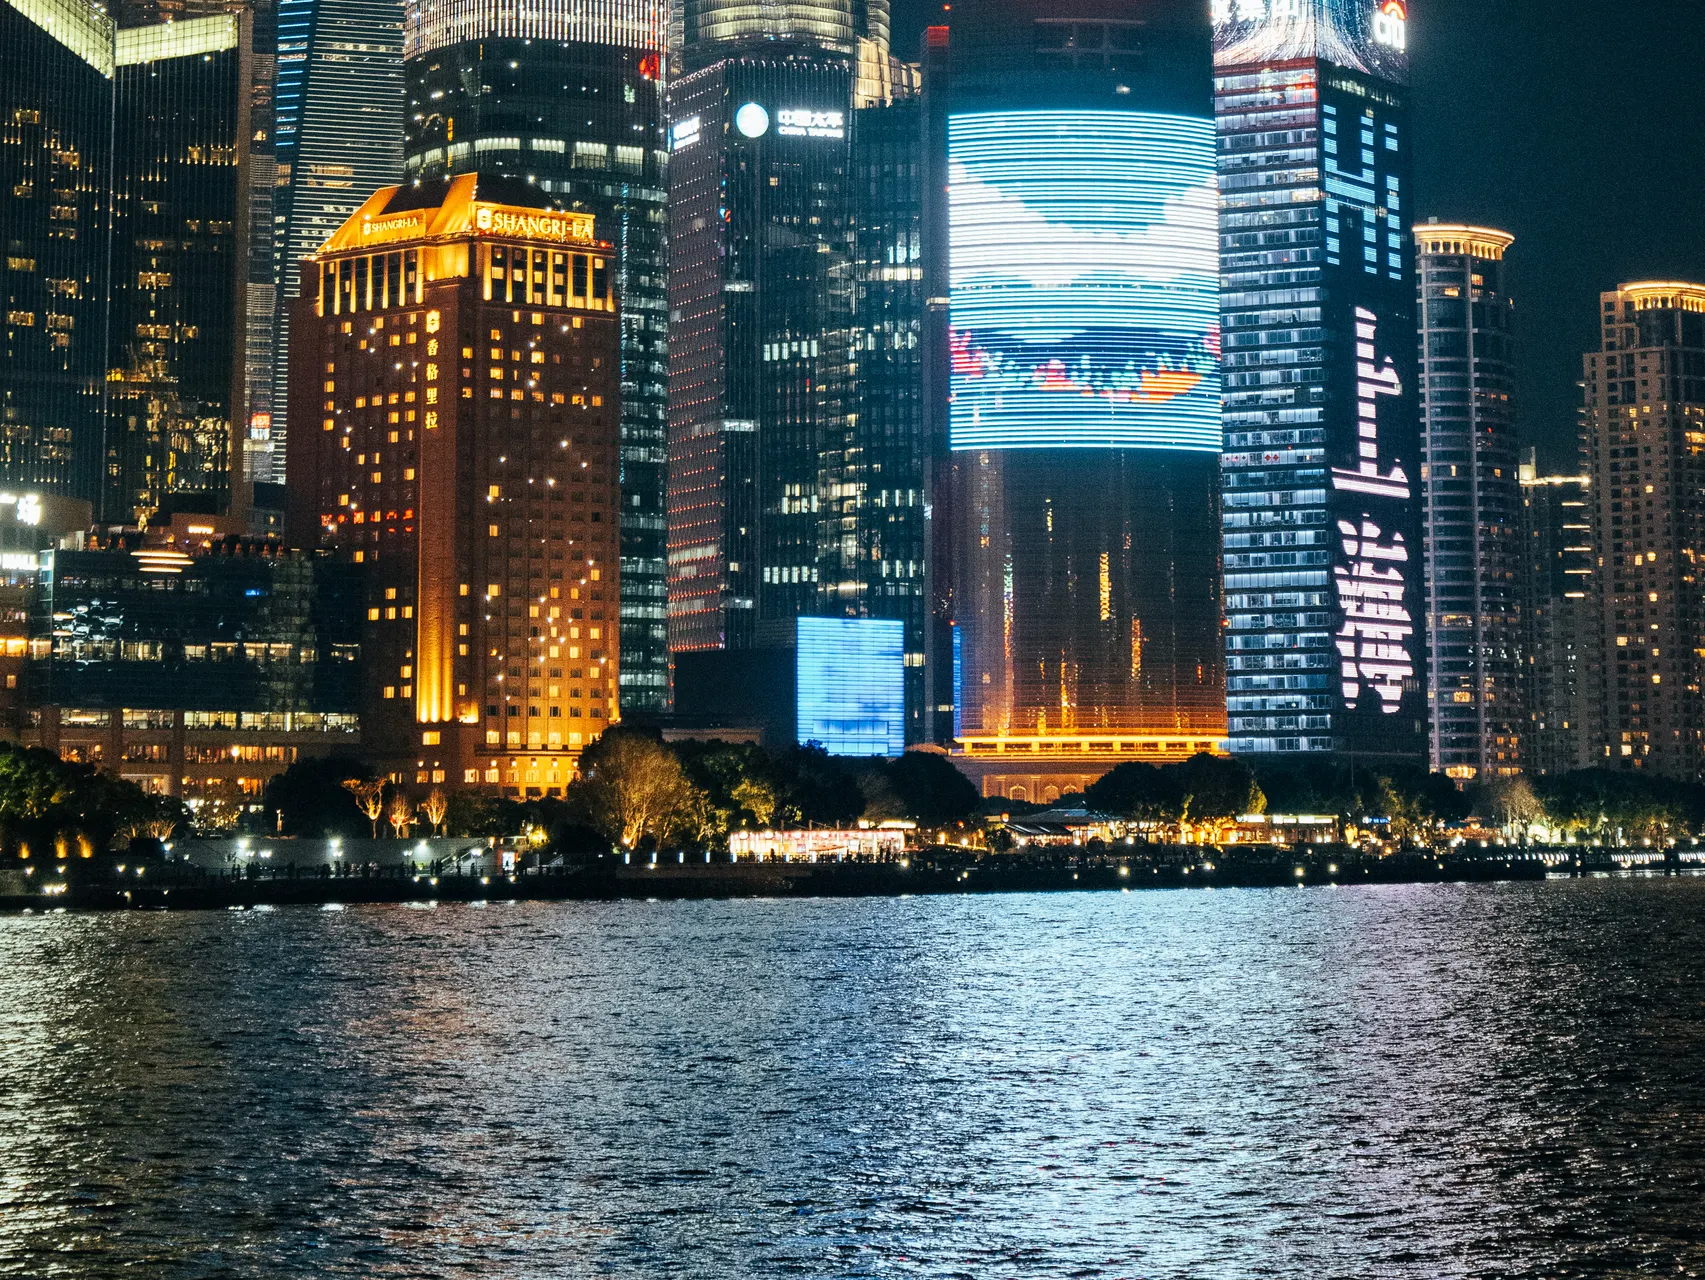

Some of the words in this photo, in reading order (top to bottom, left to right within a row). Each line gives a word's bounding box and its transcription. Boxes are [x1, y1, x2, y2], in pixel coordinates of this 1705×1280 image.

[371, 217, 418, 233] SHANGRI-LA
[494, 212, 593, 239] SHANGRI-LA
[425, 338, 439, 430] 香格里拉
[1331, 306, 1413, 713] 上海
